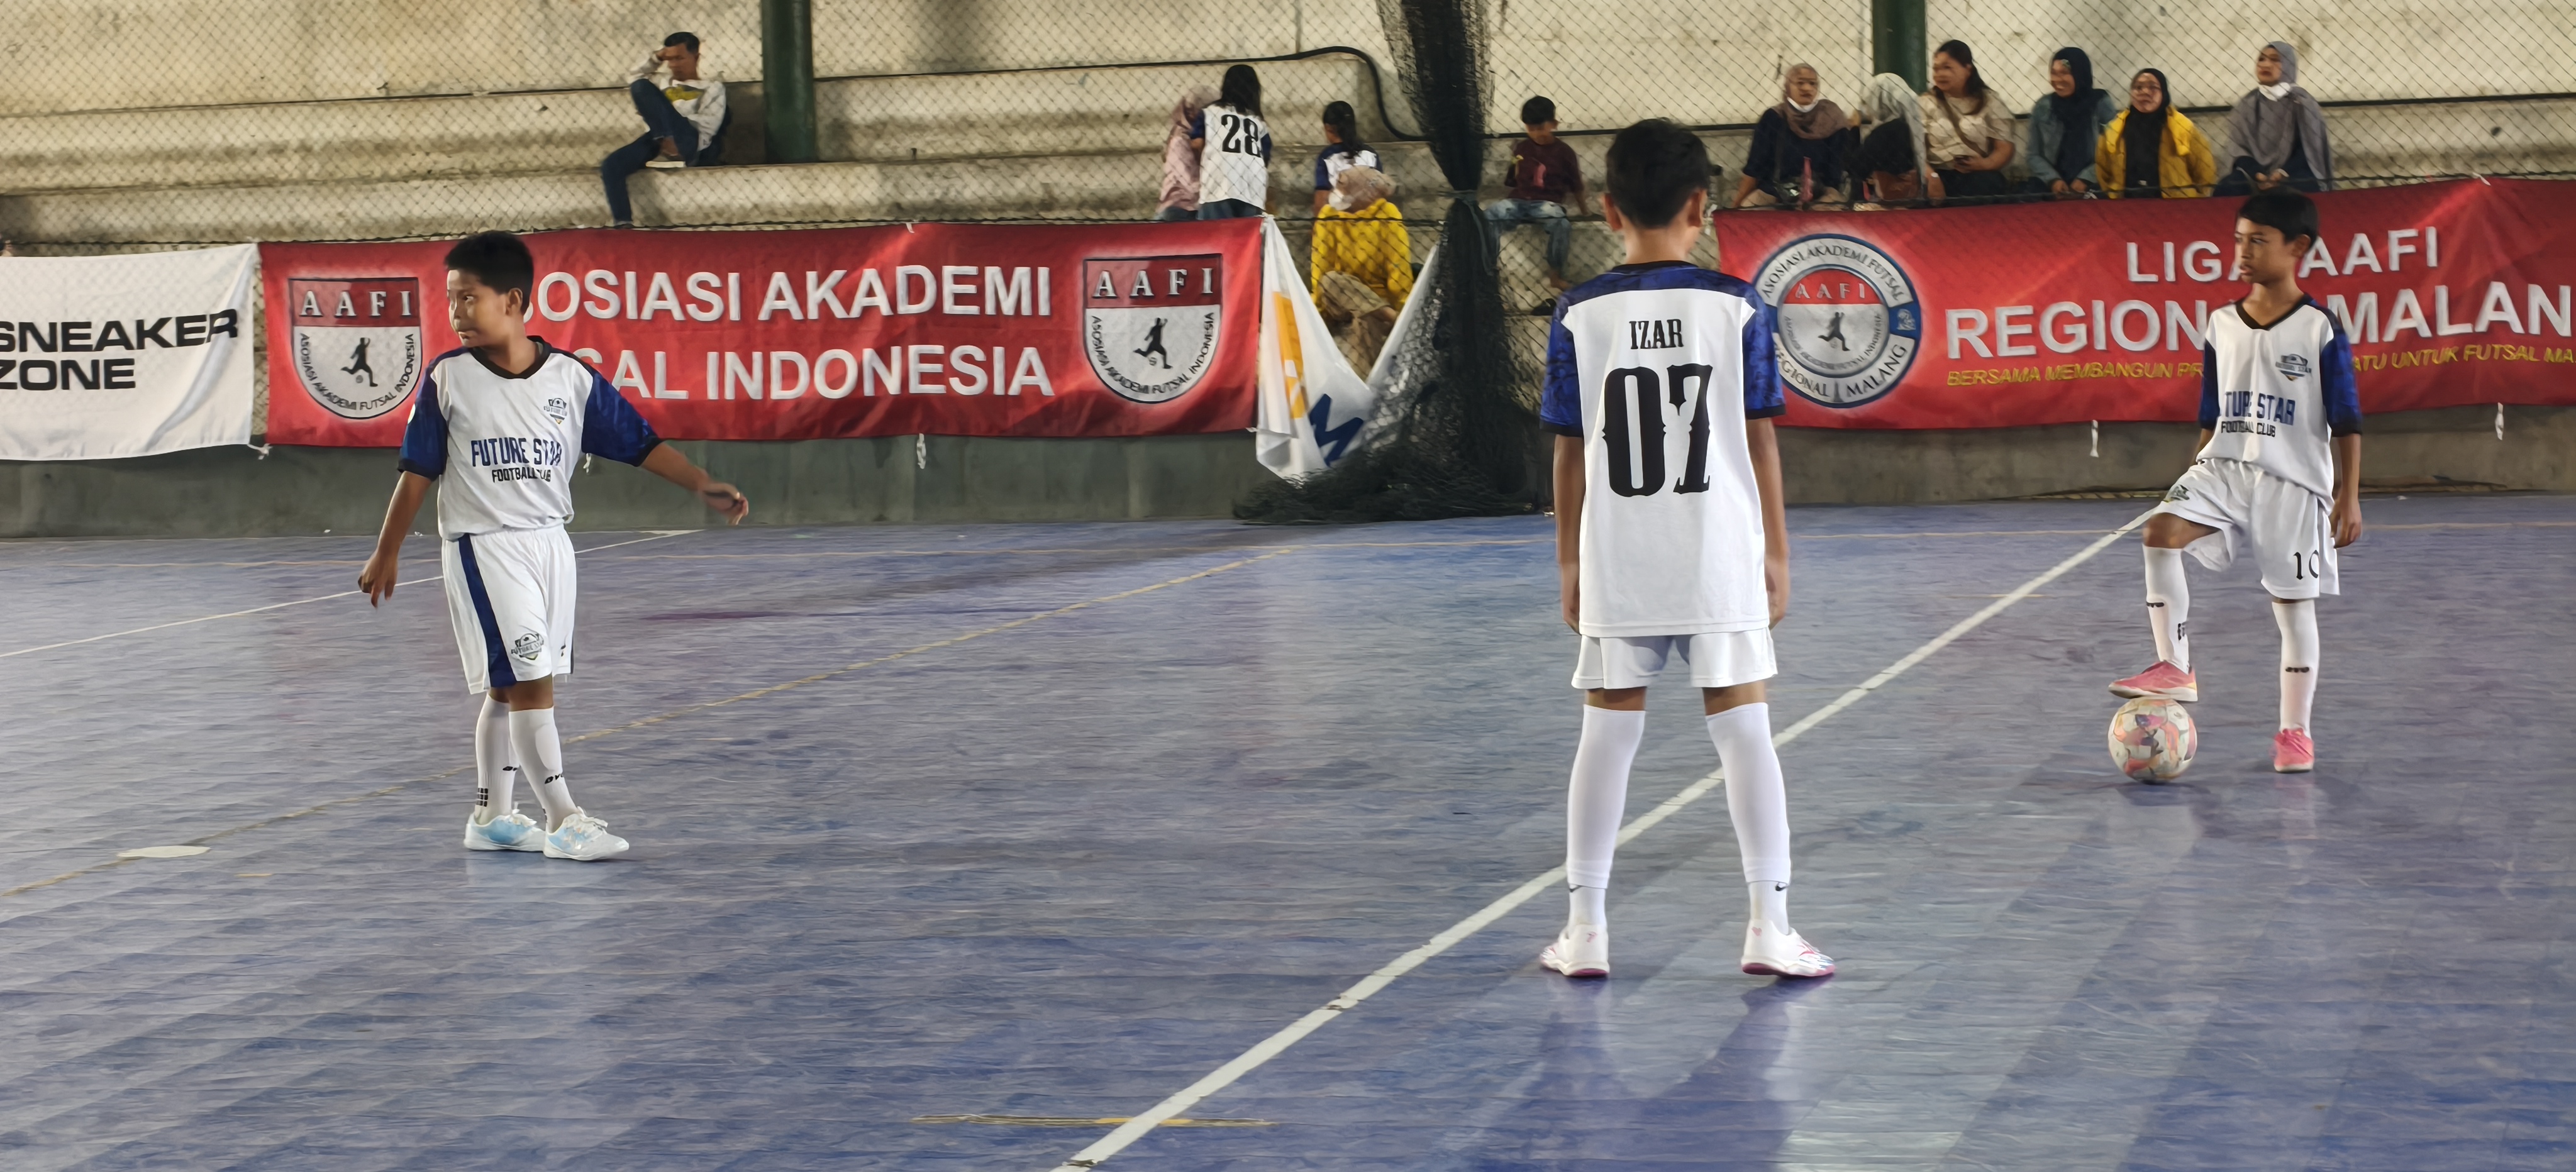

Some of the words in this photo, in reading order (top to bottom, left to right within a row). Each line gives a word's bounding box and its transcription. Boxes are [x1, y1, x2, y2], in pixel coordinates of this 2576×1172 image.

[1221, 114, 1261, 158] 28
[2298, 226, 2438, 277] AAFI
[524, 269, 741, 321] OSIASI
[758, 265, 1051, 321] AKADEMI
[1092, 268, 1213, 298] AAFI
[1795, 283, 1866, 299] AAFI
[299, 290, 412, 317] AAFI
[1629, 319, 1684, 350] IZAR
[1946, 299, 2207, 359] REGION
[706, 345, 1055, 400] INDONESIA
[1846, 344, 1907, 397] MALANG
[1947, 367, 2041, 386] BERSAMA
[2045, 361, 2174, 381] MEMBANGUN
[2177, 362, 2204, 377] PR
[2352, 353, 2388, 372] ATU
[2392, 346, 2458, 368] UNTUK
[2463, 343, 2541, 362] FUTSAL
[2543, 346, 2576, 363] MA
[2257, 393, 2296, 426] STAR
[1602, 363, 1713, 497] 07
[2256, 422, 2276, 437] CLUB
[471, 437, 530, 467] FUTURE
[492, 467, 538, 483] FOOTBALL
